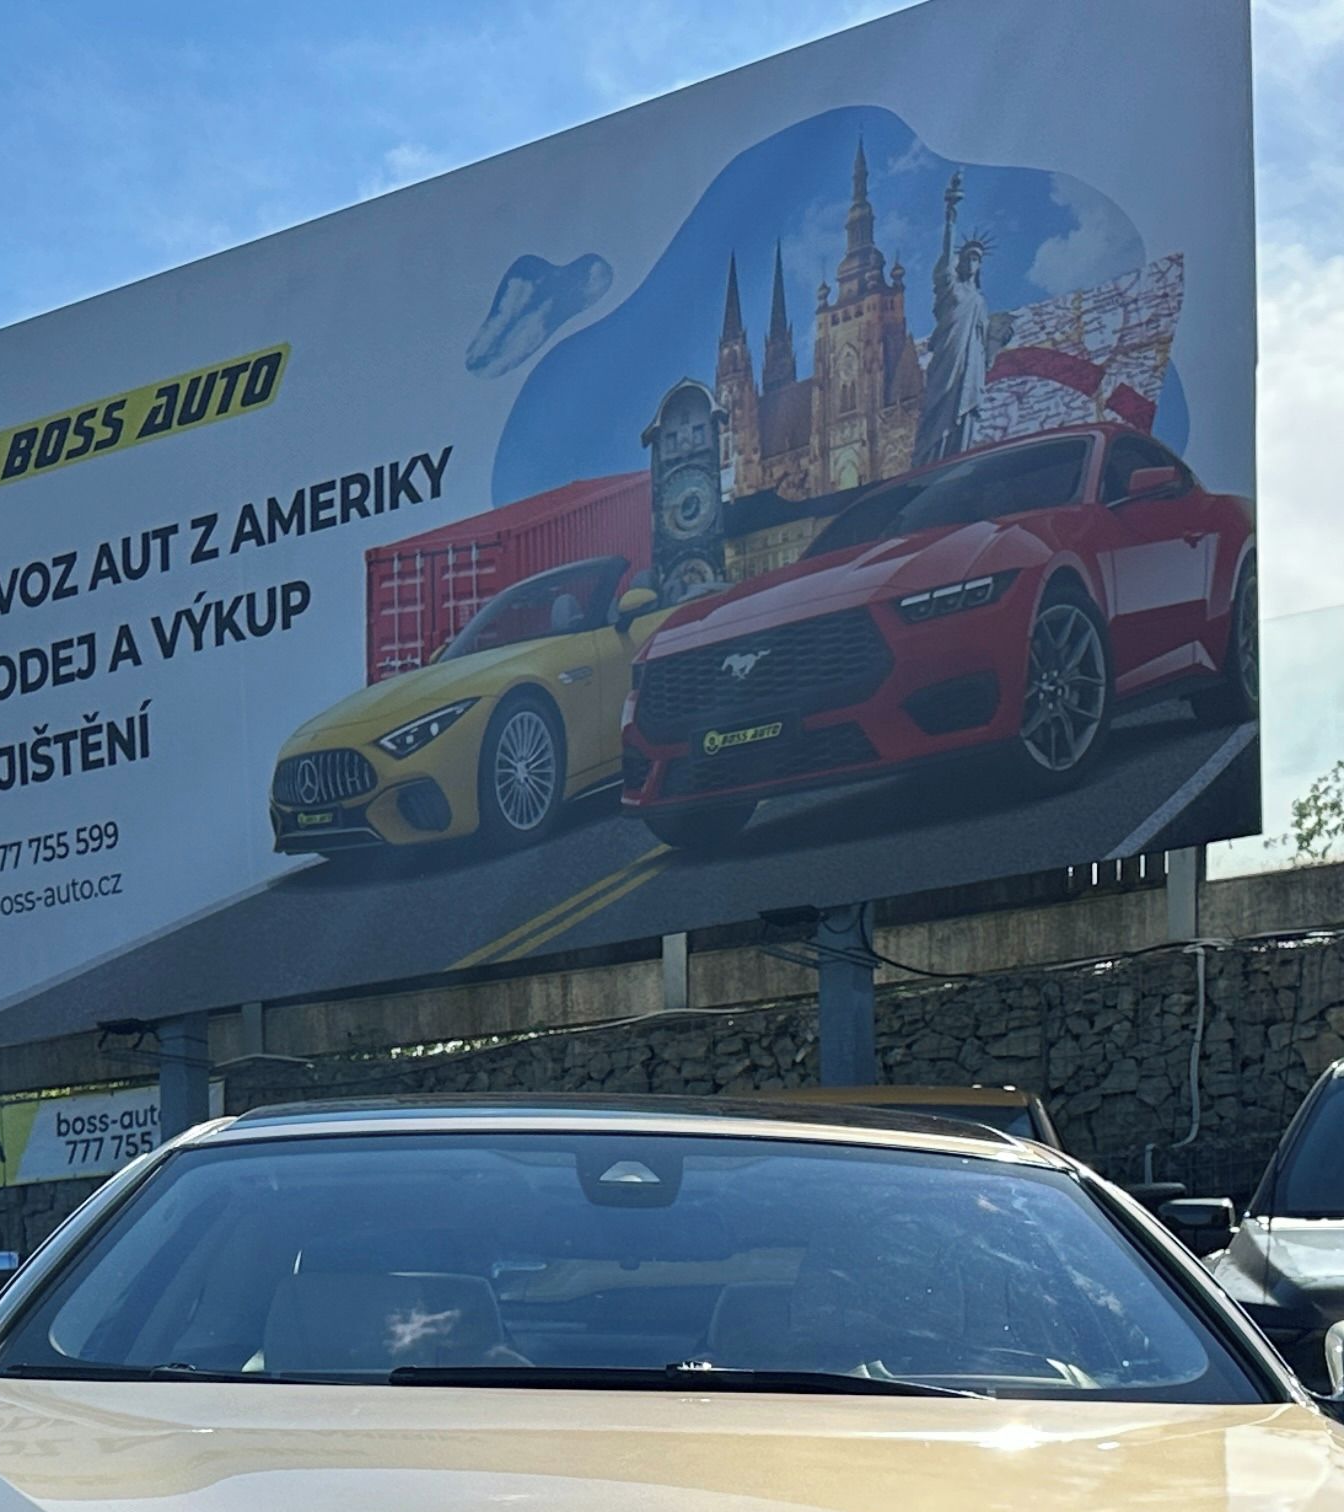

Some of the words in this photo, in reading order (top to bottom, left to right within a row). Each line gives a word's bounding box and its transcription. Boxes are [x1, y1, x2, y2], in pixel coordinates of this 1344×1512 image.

[1, 399, 127, 480] BOSS
[136, 352, 282, 439] AUTO
[88, 525, 179, 592] AUT
[190, 512, 219, 564] Z
[230, 445, 454, 556] AMERIKY
[109, 624, 142, 673] A
[151, 580, 311, 660] VÝKUP
[28, 832, 70, 865] 755
[76, 821, 119, 853] 599
[57, 1104, 160, 1137] boss-aut
[66, 1137, 104, 1165] 777
[111, 1131, 154, 1160] 755
